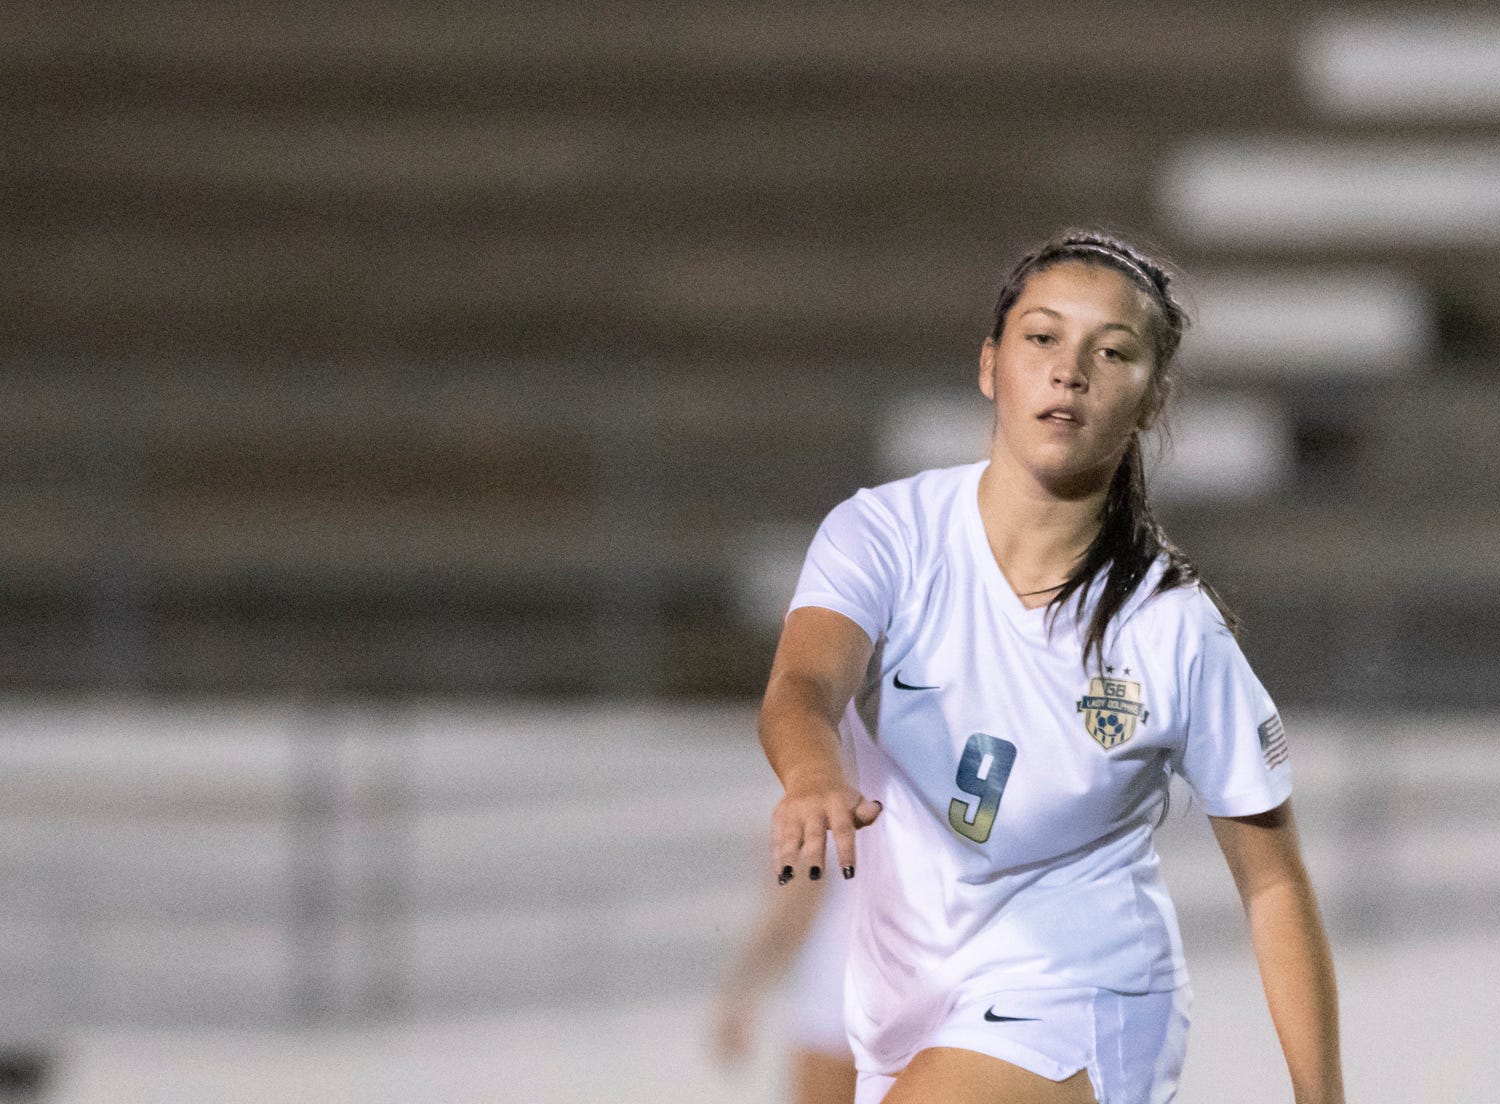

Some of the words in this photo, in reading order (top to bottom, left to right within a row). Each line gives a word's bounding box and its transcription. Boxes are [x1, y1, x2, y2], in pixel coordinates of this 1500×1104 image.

[1104, 682, 1126, 697] GB
[1086, 699, 1105, 708] LADY
[948, 733, 1017, 843] 9
